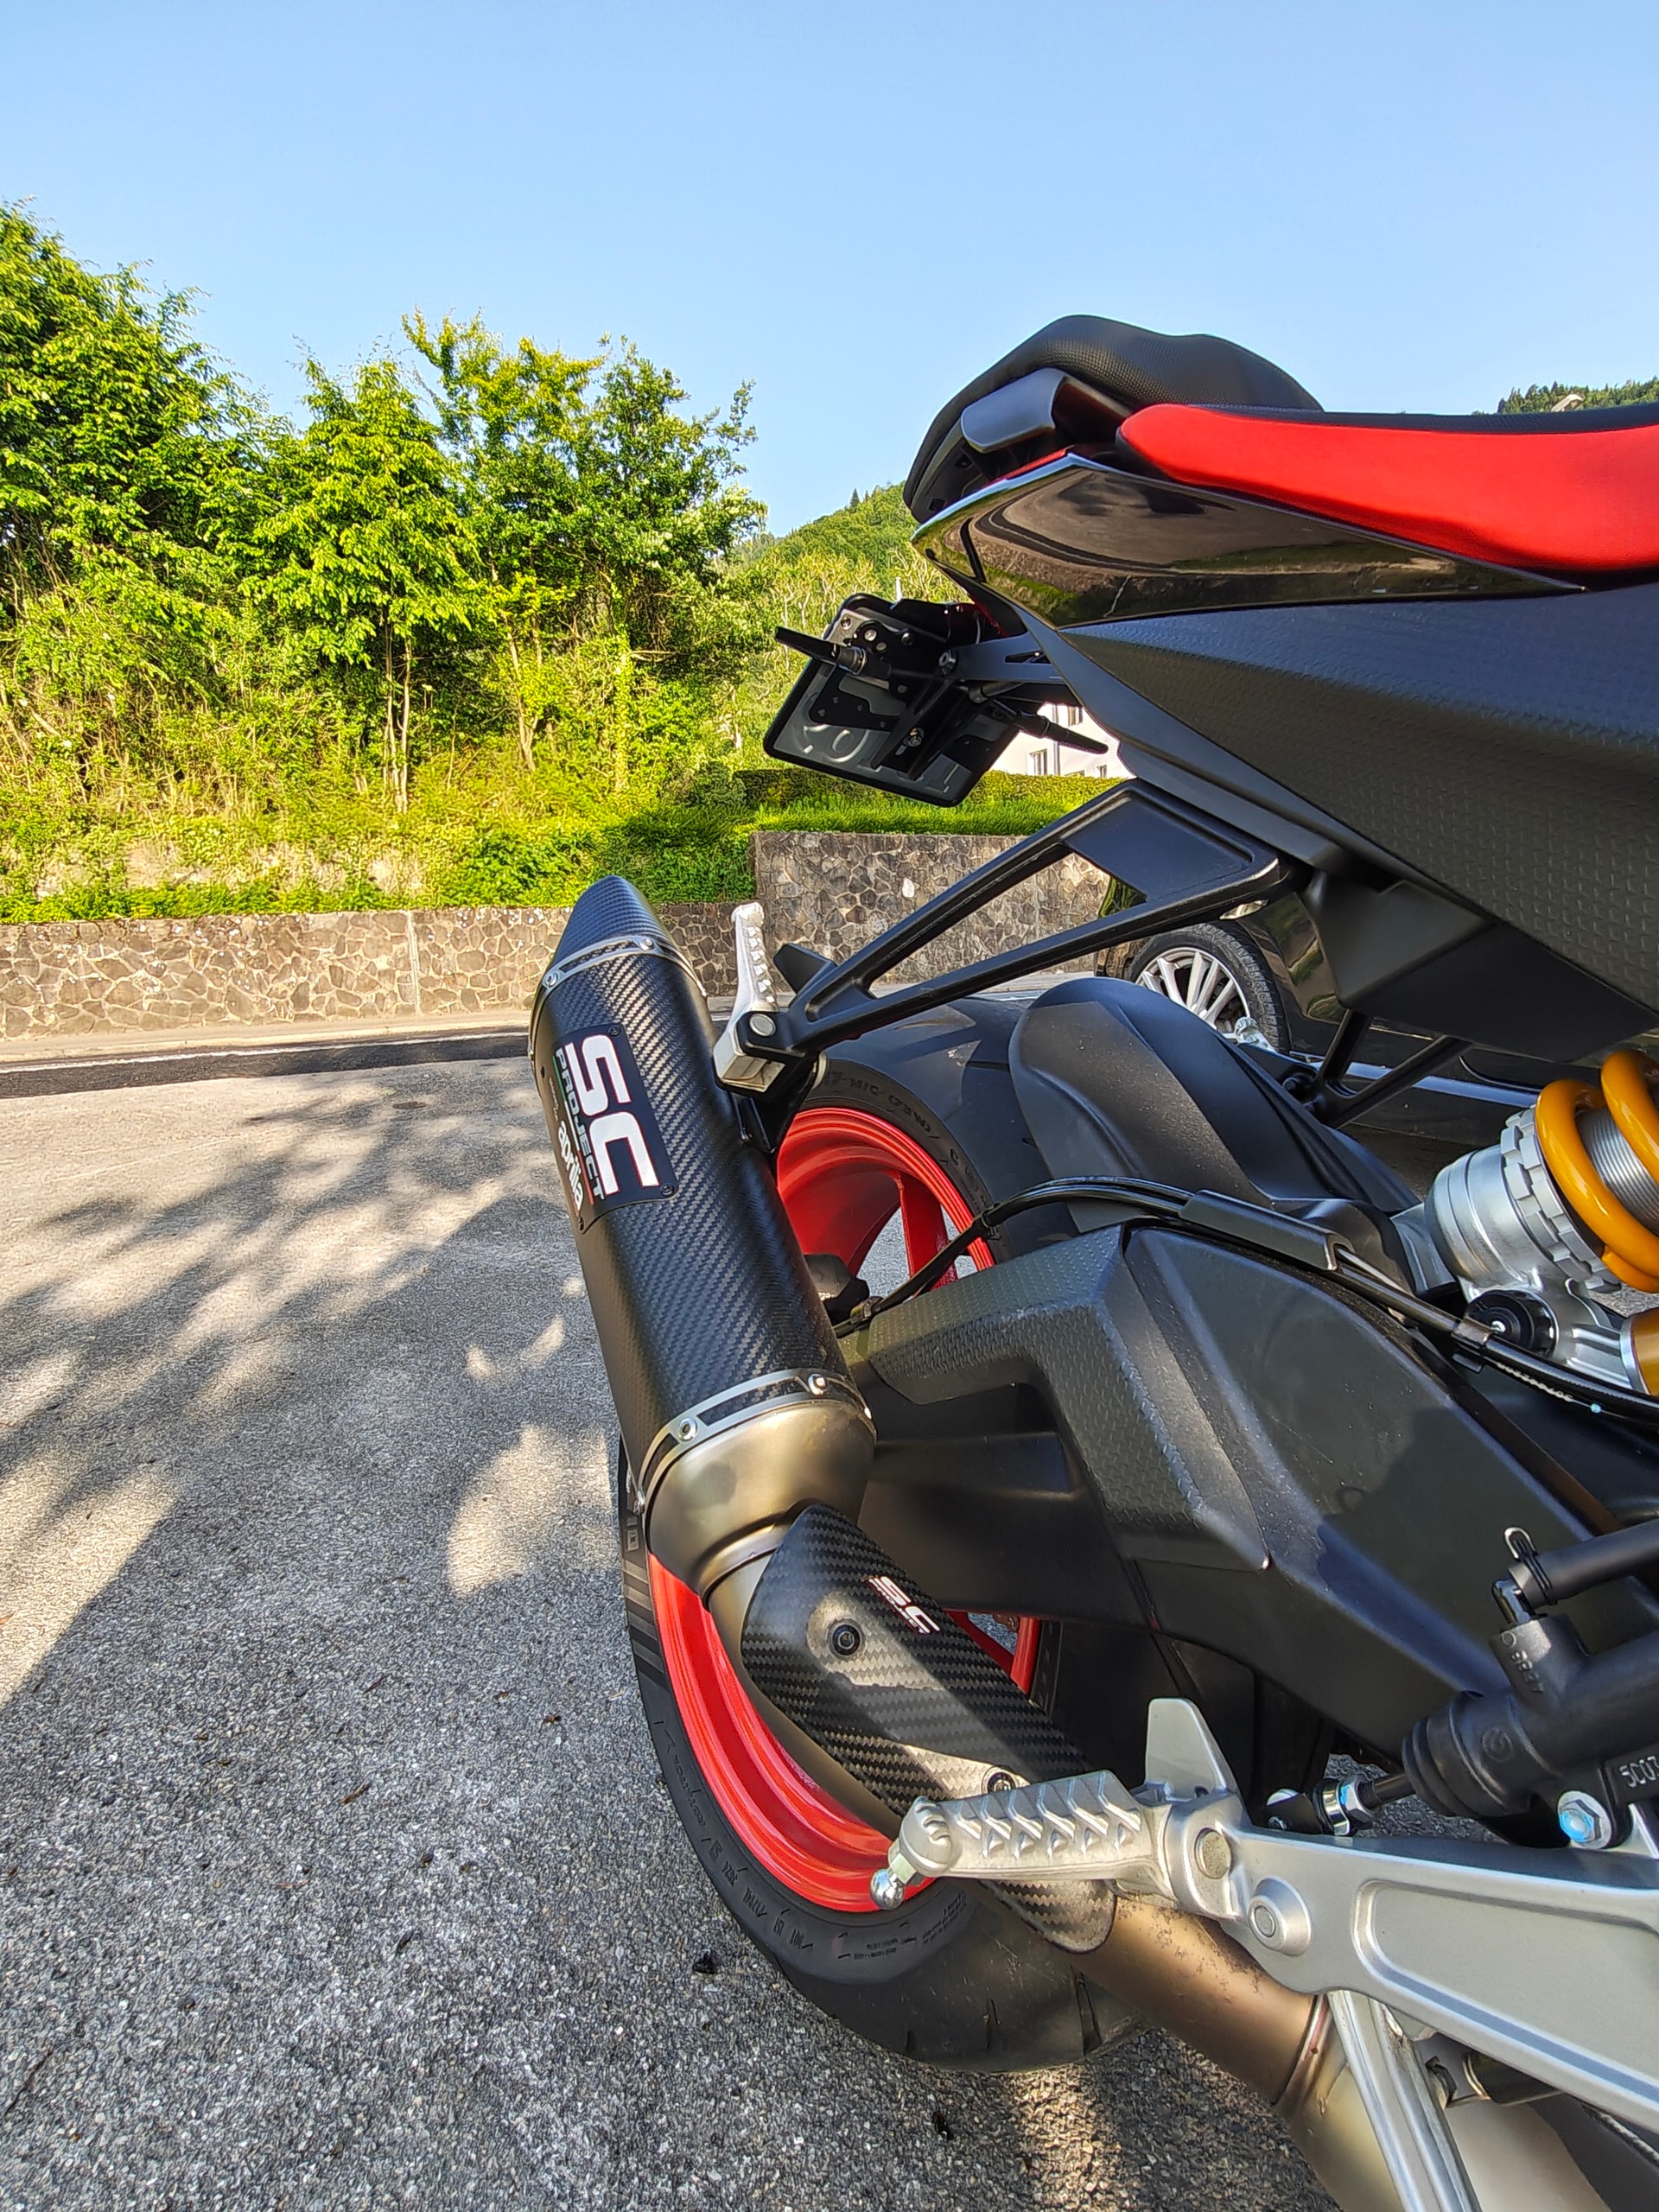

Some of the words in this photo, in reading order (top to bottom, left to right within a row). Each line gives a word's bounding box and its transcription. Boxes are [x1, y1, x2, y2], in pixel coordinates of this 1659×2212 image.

[556, 1047, 605, 1199] PROJECT
[557, 1119, 584, 1211] aprilia
[564, 1034, 659, 1195] SC
[874, 1575, 940, 1634] SC
